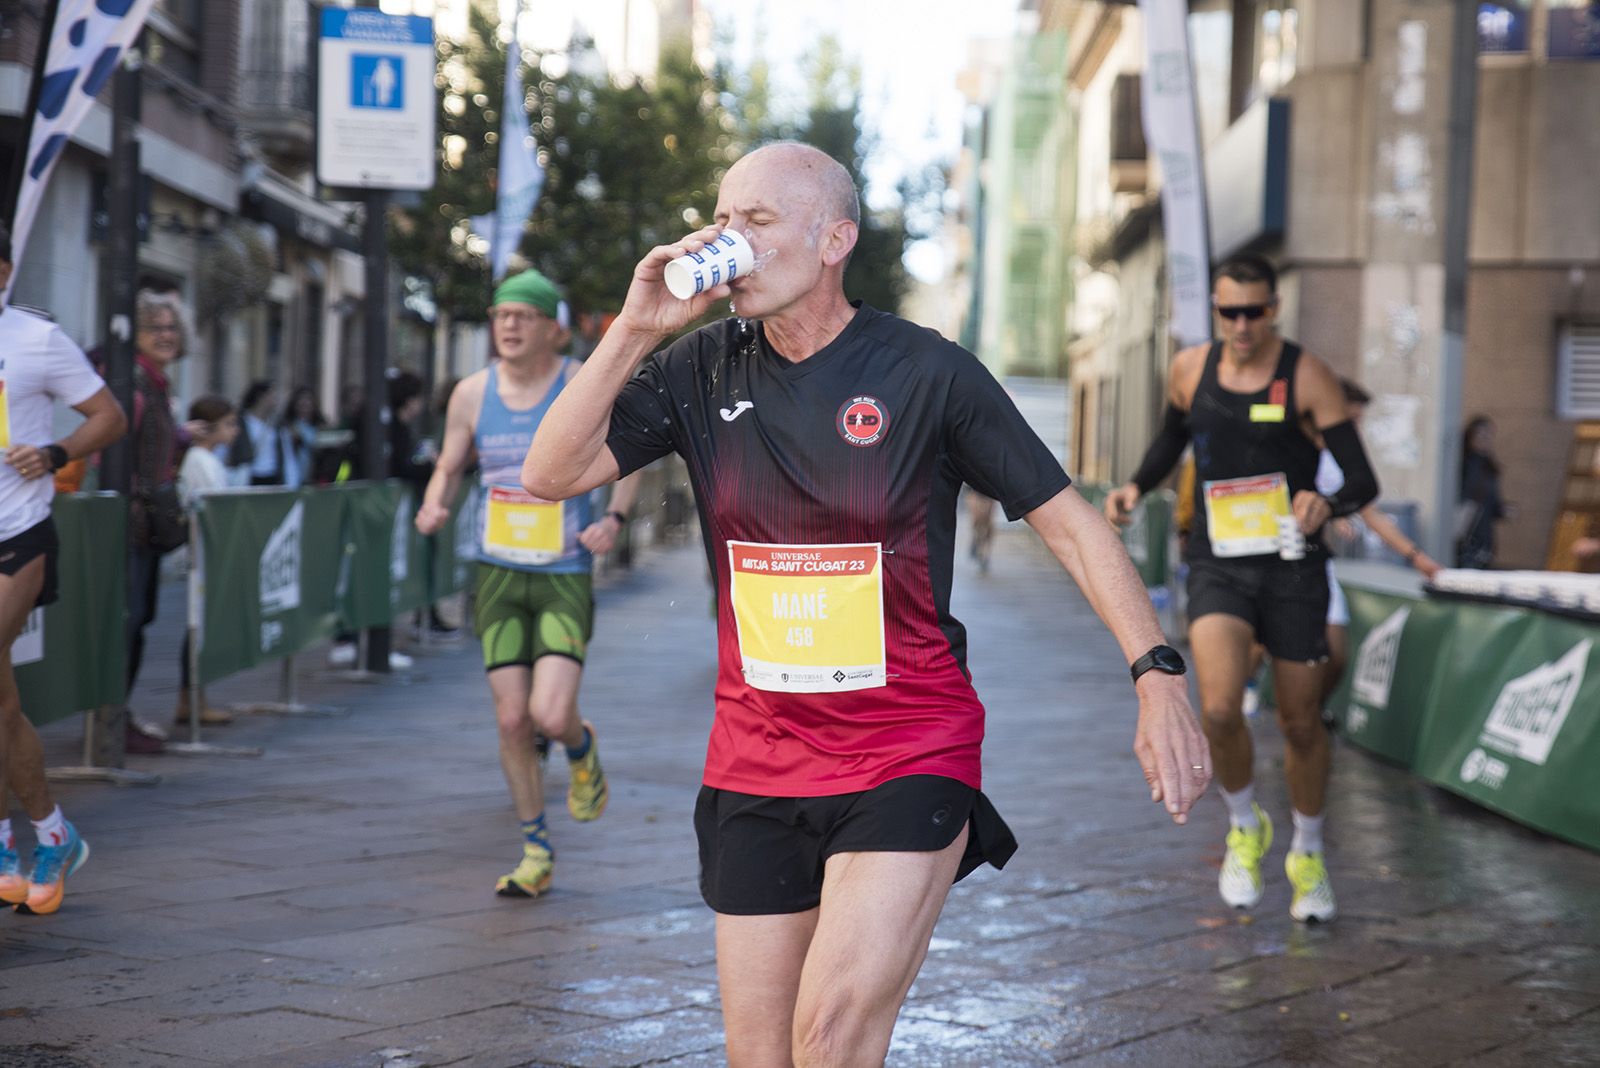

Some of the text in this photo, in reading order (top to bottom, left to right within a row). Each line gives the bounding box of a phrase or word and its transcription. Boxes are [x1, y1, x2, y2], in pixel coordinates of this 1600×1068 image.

[845, 434, 880, 444] SANT CUGAT
[771, 552, 822, 561] UNIVERSAE
[742, 557, 865, 572] MITJA SANT CUGAT 23
[773, 587, 828, 620] MANÉ
[786, 626, 814, 647] 458
